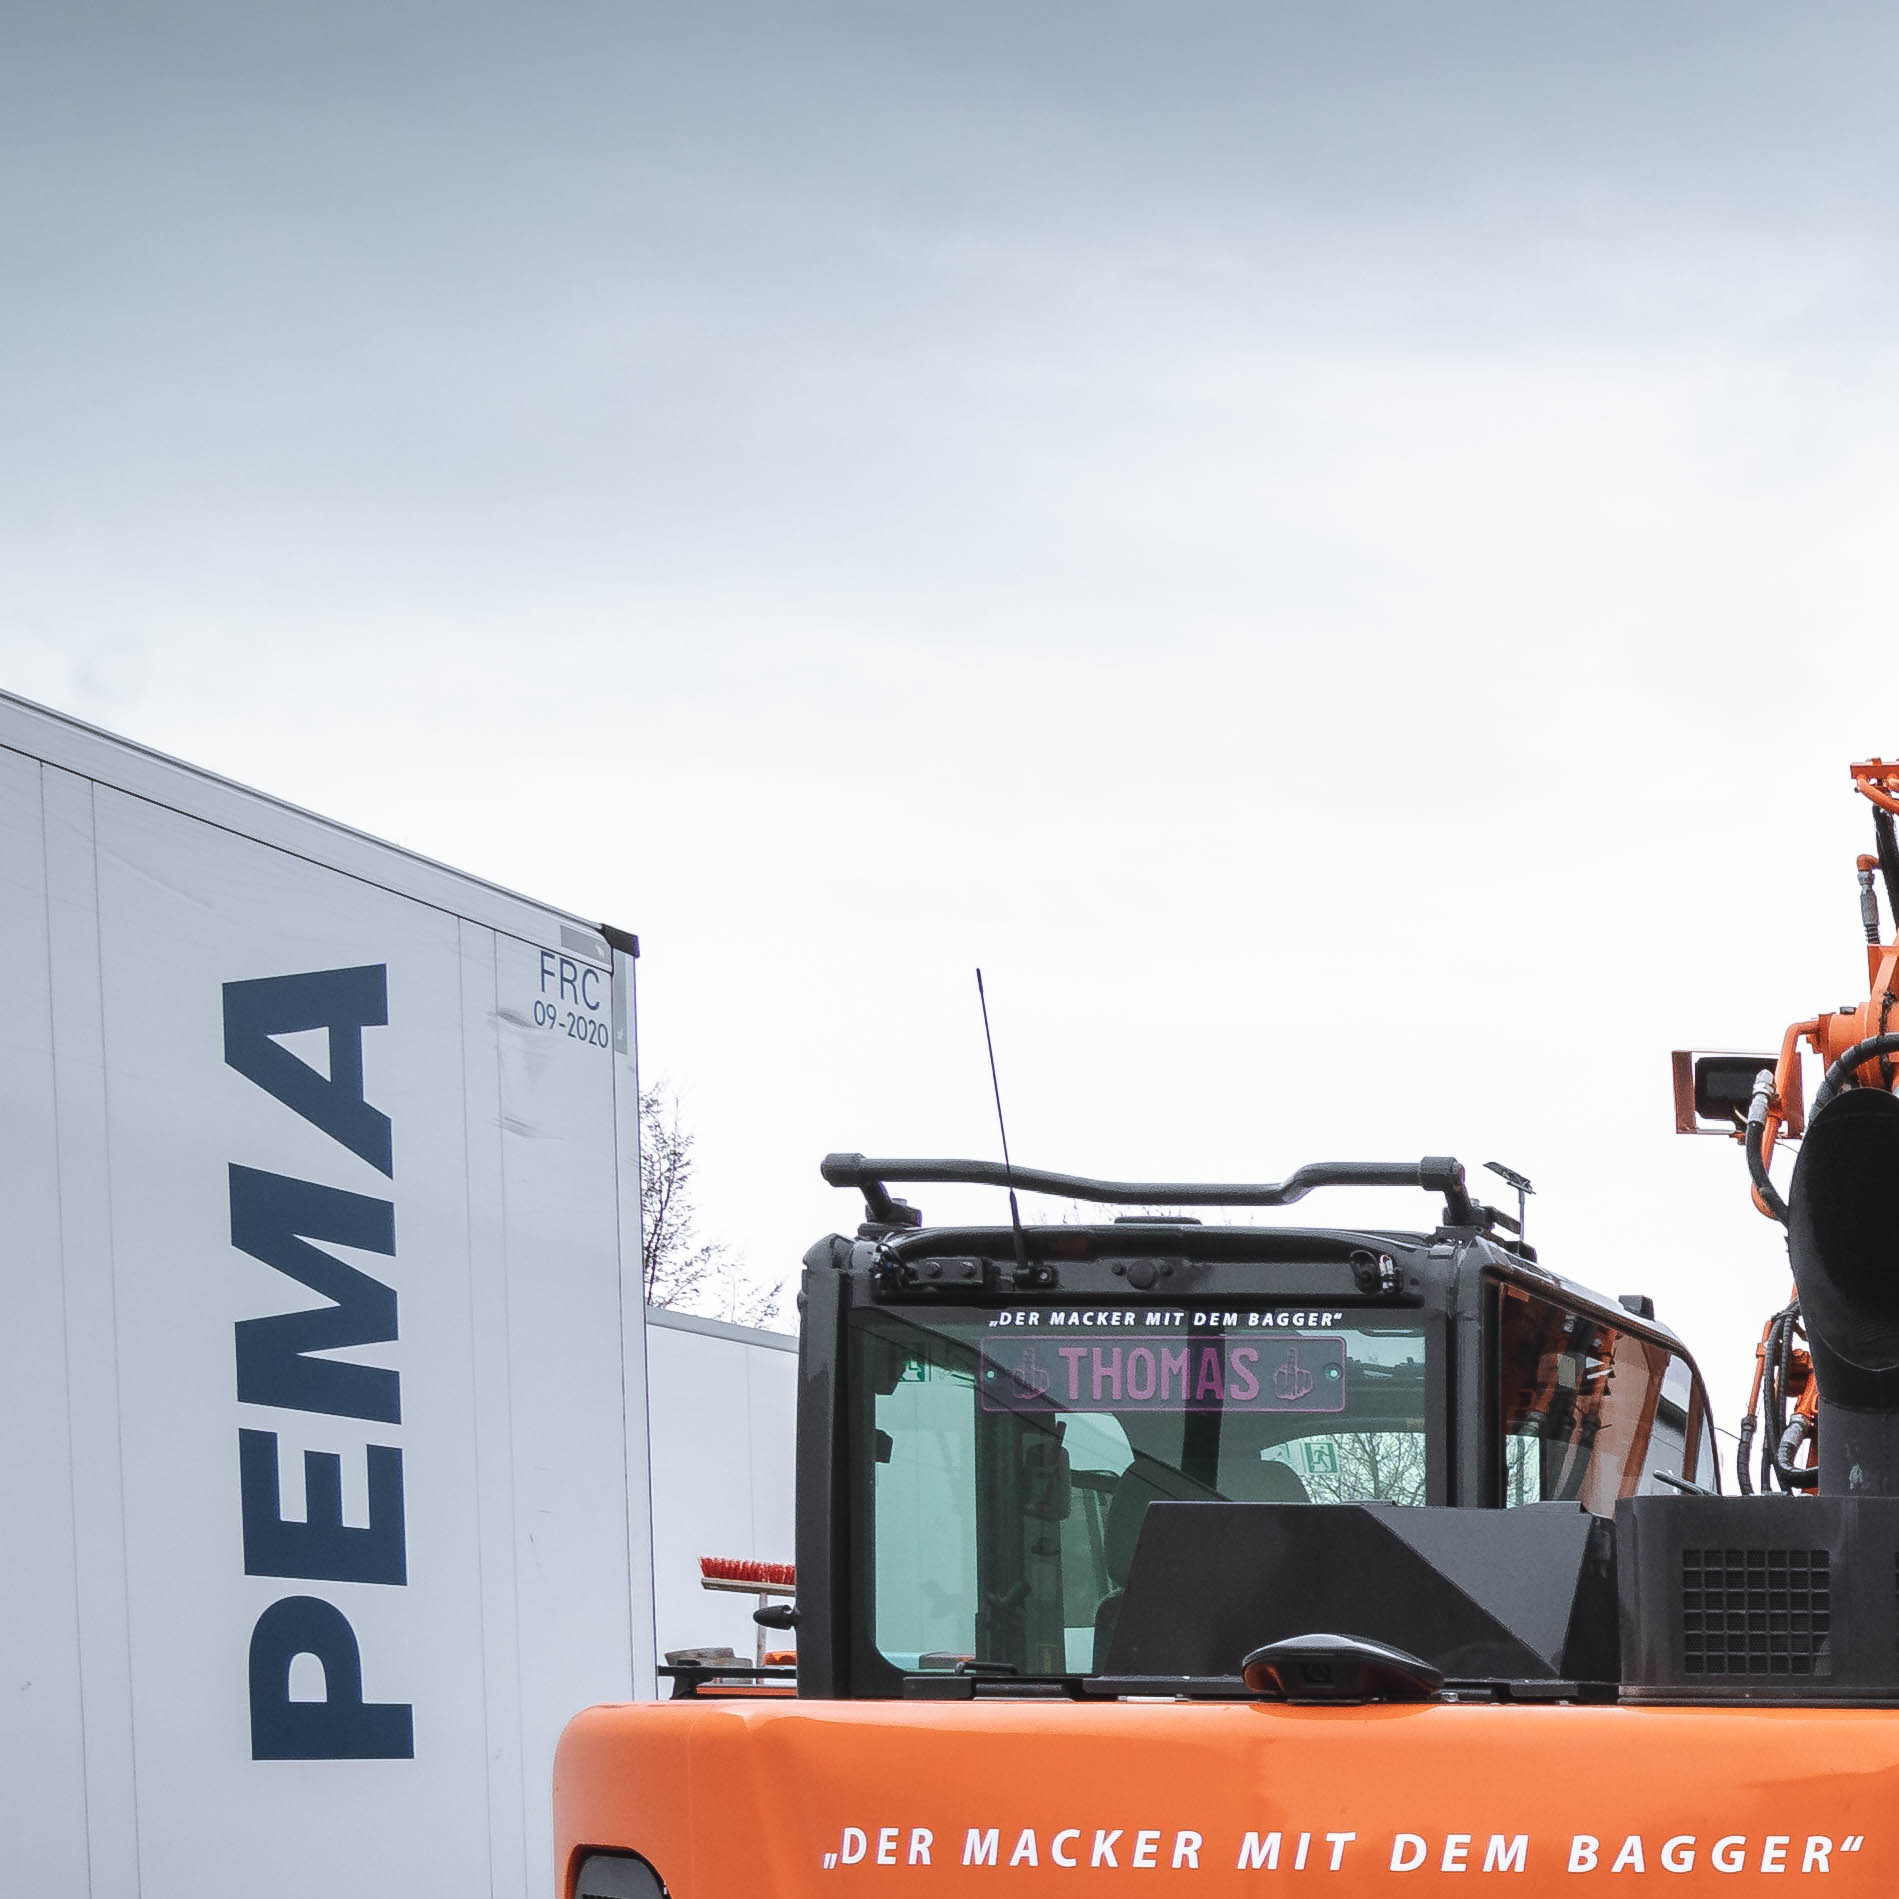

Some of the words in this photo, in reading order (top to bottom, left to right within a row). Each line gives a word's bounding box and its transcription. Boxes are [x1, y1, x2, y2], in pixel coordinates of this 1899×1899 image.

[541, 950, 600, 1011] FRC
[534, 1000, 609, 1049] 09-2020
[1050, 1311, 1136, 1326] MACKER
[1145, 1312, 1185, 1326] MIT
[1193, 1312, 1239, 1327] DEM
[222, 963, 415, 1761] PEMA
[1058, 1346, 1260, 1401] THOMAS
[961, 1827, 1204, 1870] MACKER
[1236, 1831, 1356, 1872] MIT
[1389, 1832, 1530, 1874] DEM
